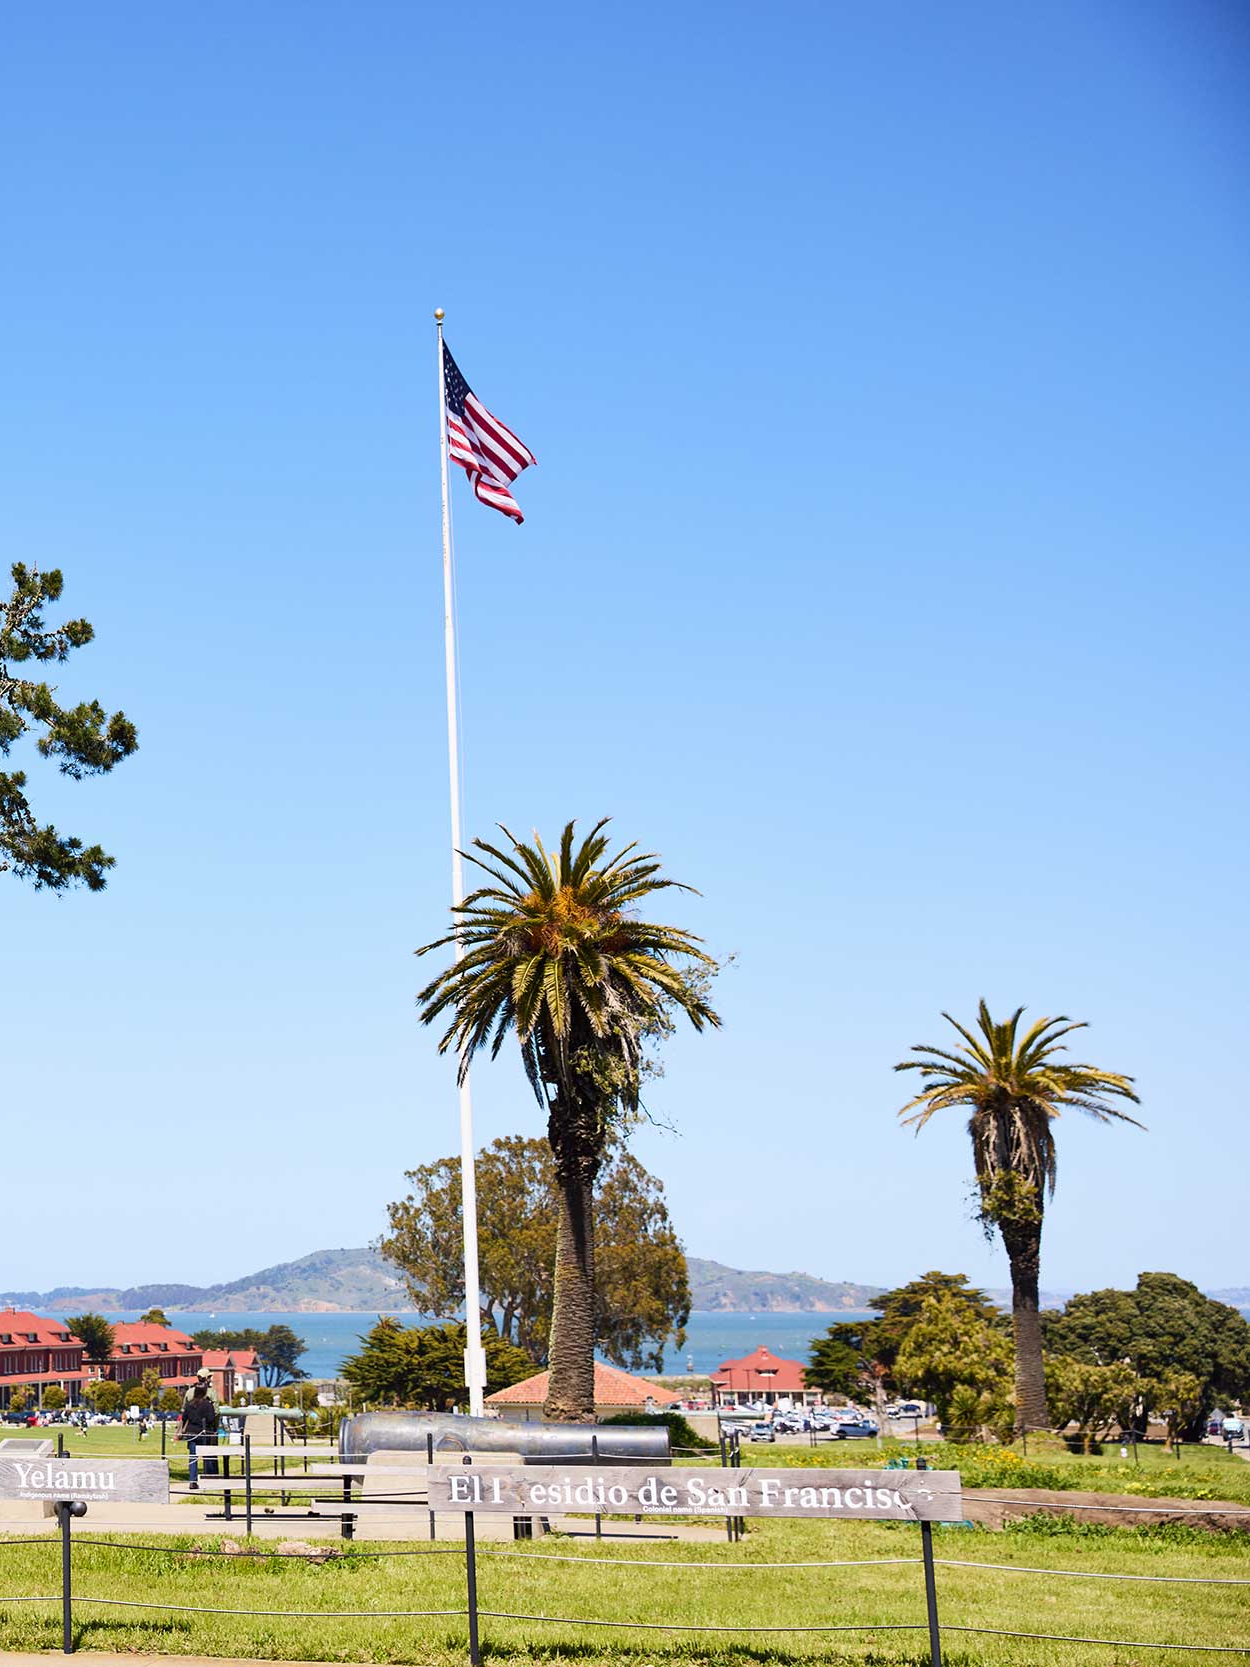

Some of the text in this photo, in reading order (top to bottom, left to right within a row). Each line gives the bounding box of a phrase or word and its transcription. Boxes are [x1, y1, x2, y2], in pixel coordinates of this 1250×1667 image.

[12, 1463, 116, 1490] Yelamu
[448, 1475, 483, 1503] El
[637, 1477, 678, 1506] de
[686, 1478, 750, 1506] San
[642, 1505, 672, 1513] Colonial
[694, 1506, 728, 1515] (Spanish)
